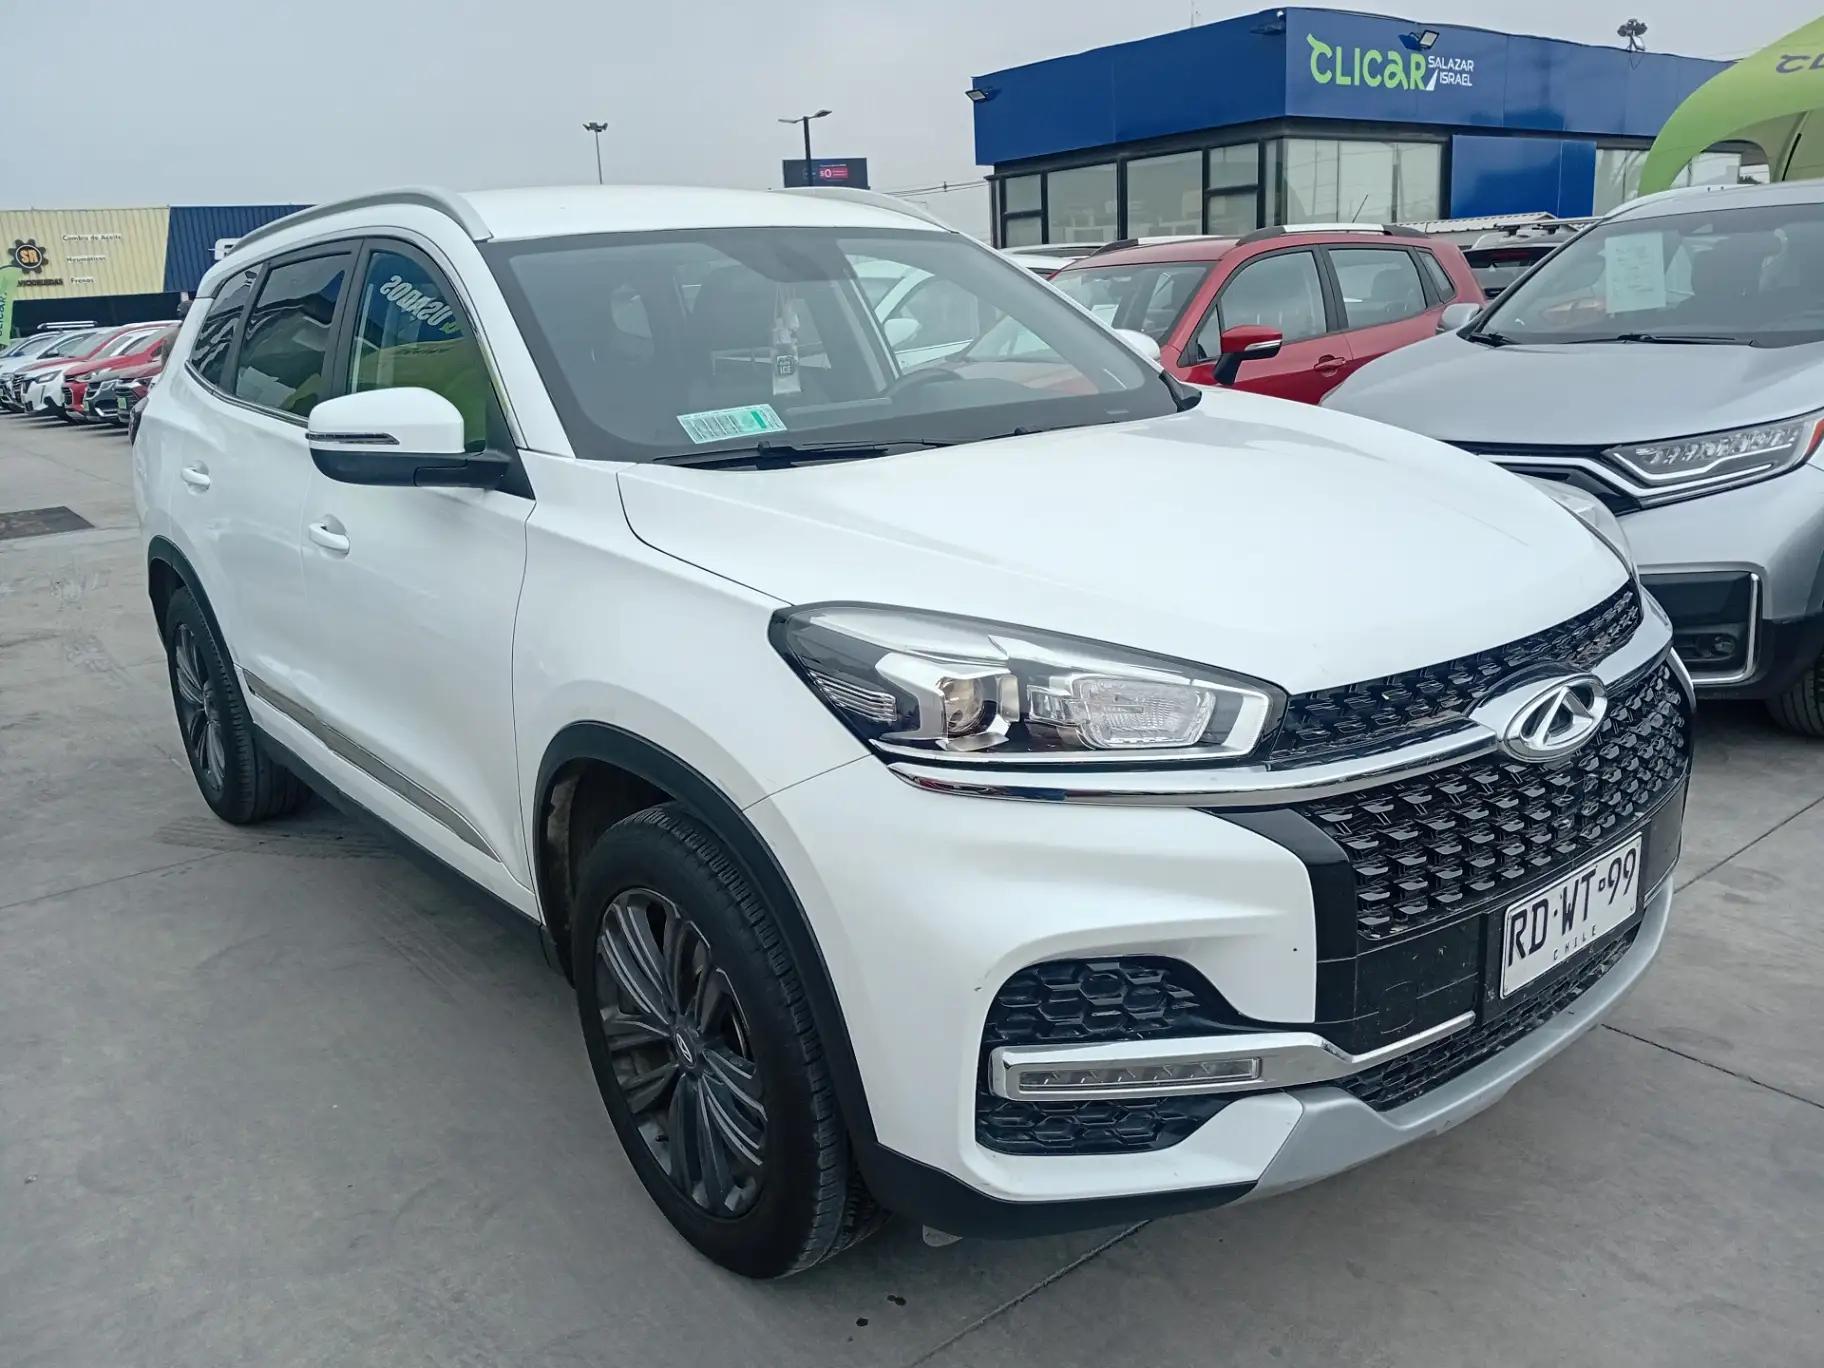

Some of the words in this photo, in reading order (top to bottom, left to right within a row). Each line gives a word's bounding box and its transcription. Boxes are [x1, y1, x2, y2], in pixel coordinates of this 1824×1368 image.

[1428, 55, 1474, 72] SALAZAR
[1440, 71, 1473, 87] ISRAEL
[1553, 925, 1597, 961] CHILE
